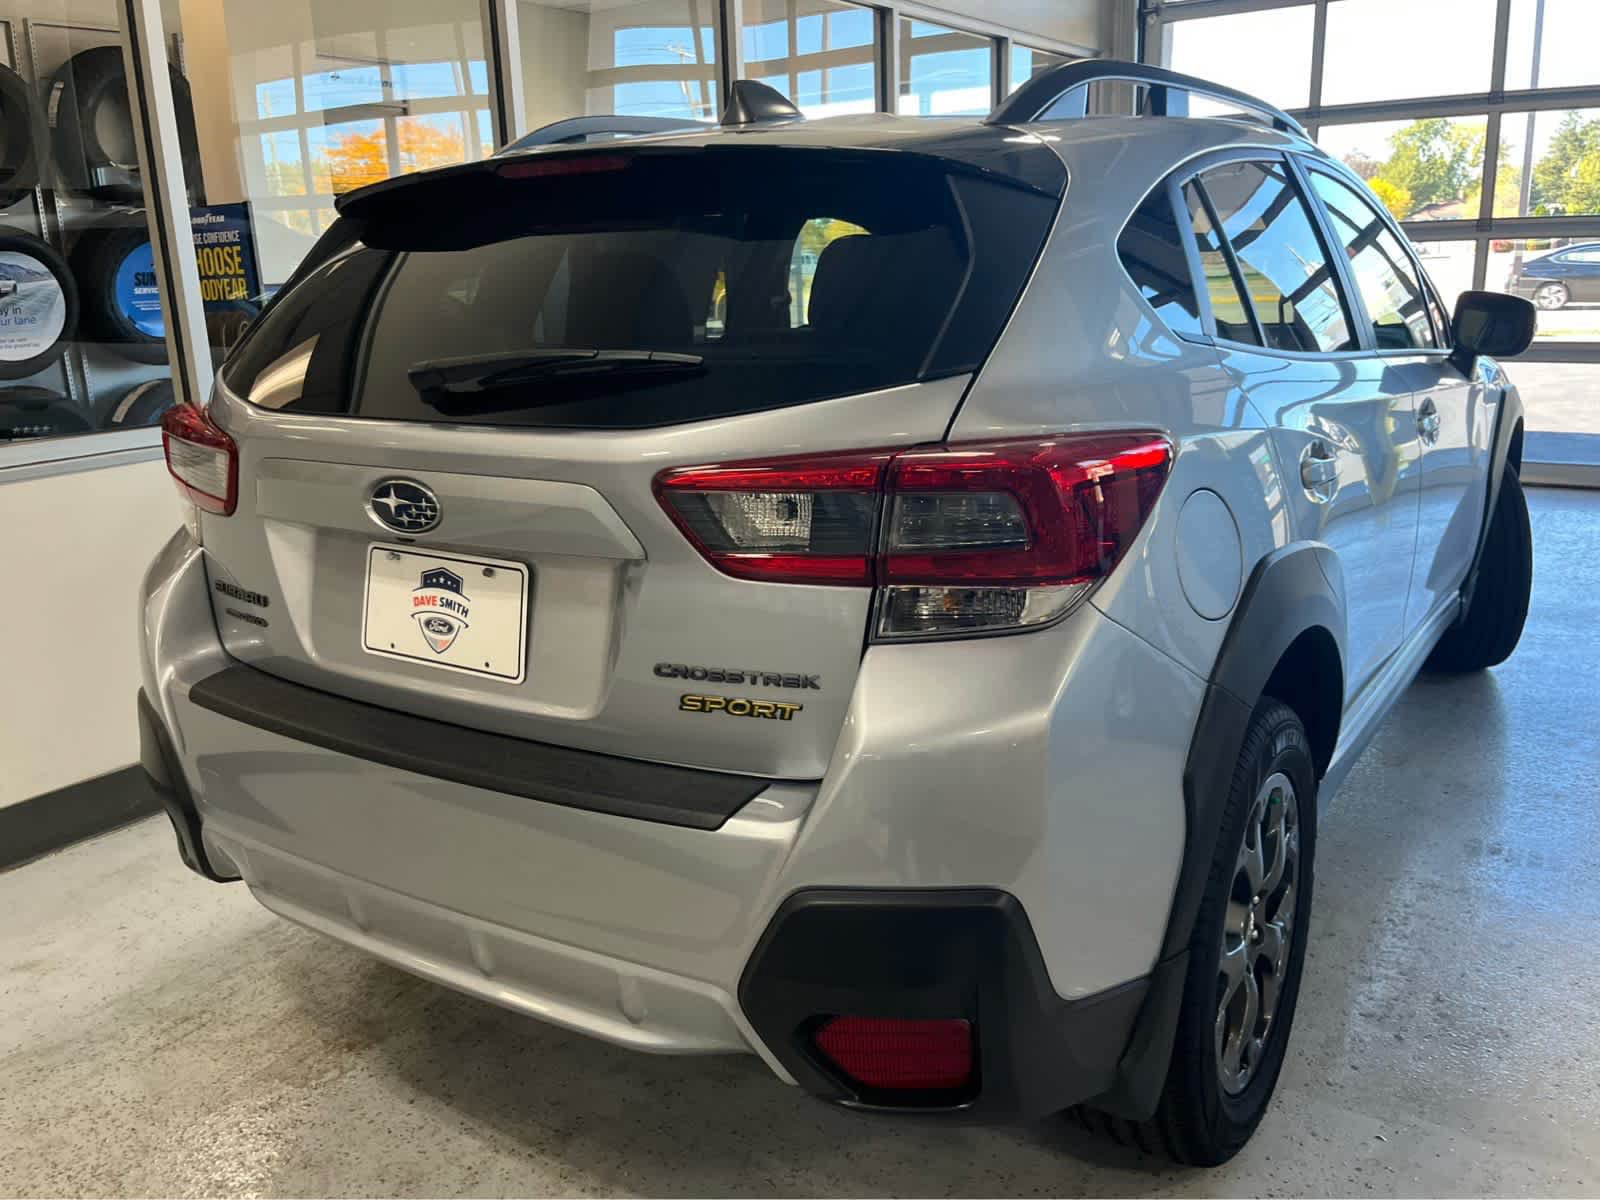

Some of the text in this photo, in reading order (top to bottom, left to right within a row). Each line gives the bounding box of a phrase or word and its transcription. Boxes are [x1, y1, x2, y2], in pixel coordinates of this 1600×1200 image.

[191, 213, 224, 224] OODYEAR
[203, 230, 240, 243] CONFIDENCE
[198, 246, 245, 276] HOOSE
[201, 277, 248, 300] ODYEAR
[413, 595, 469, 618] DAVE SMITH
[653, 662, 821, 690] CROSSTREK
[678, 693, 803, 720] SPORT
